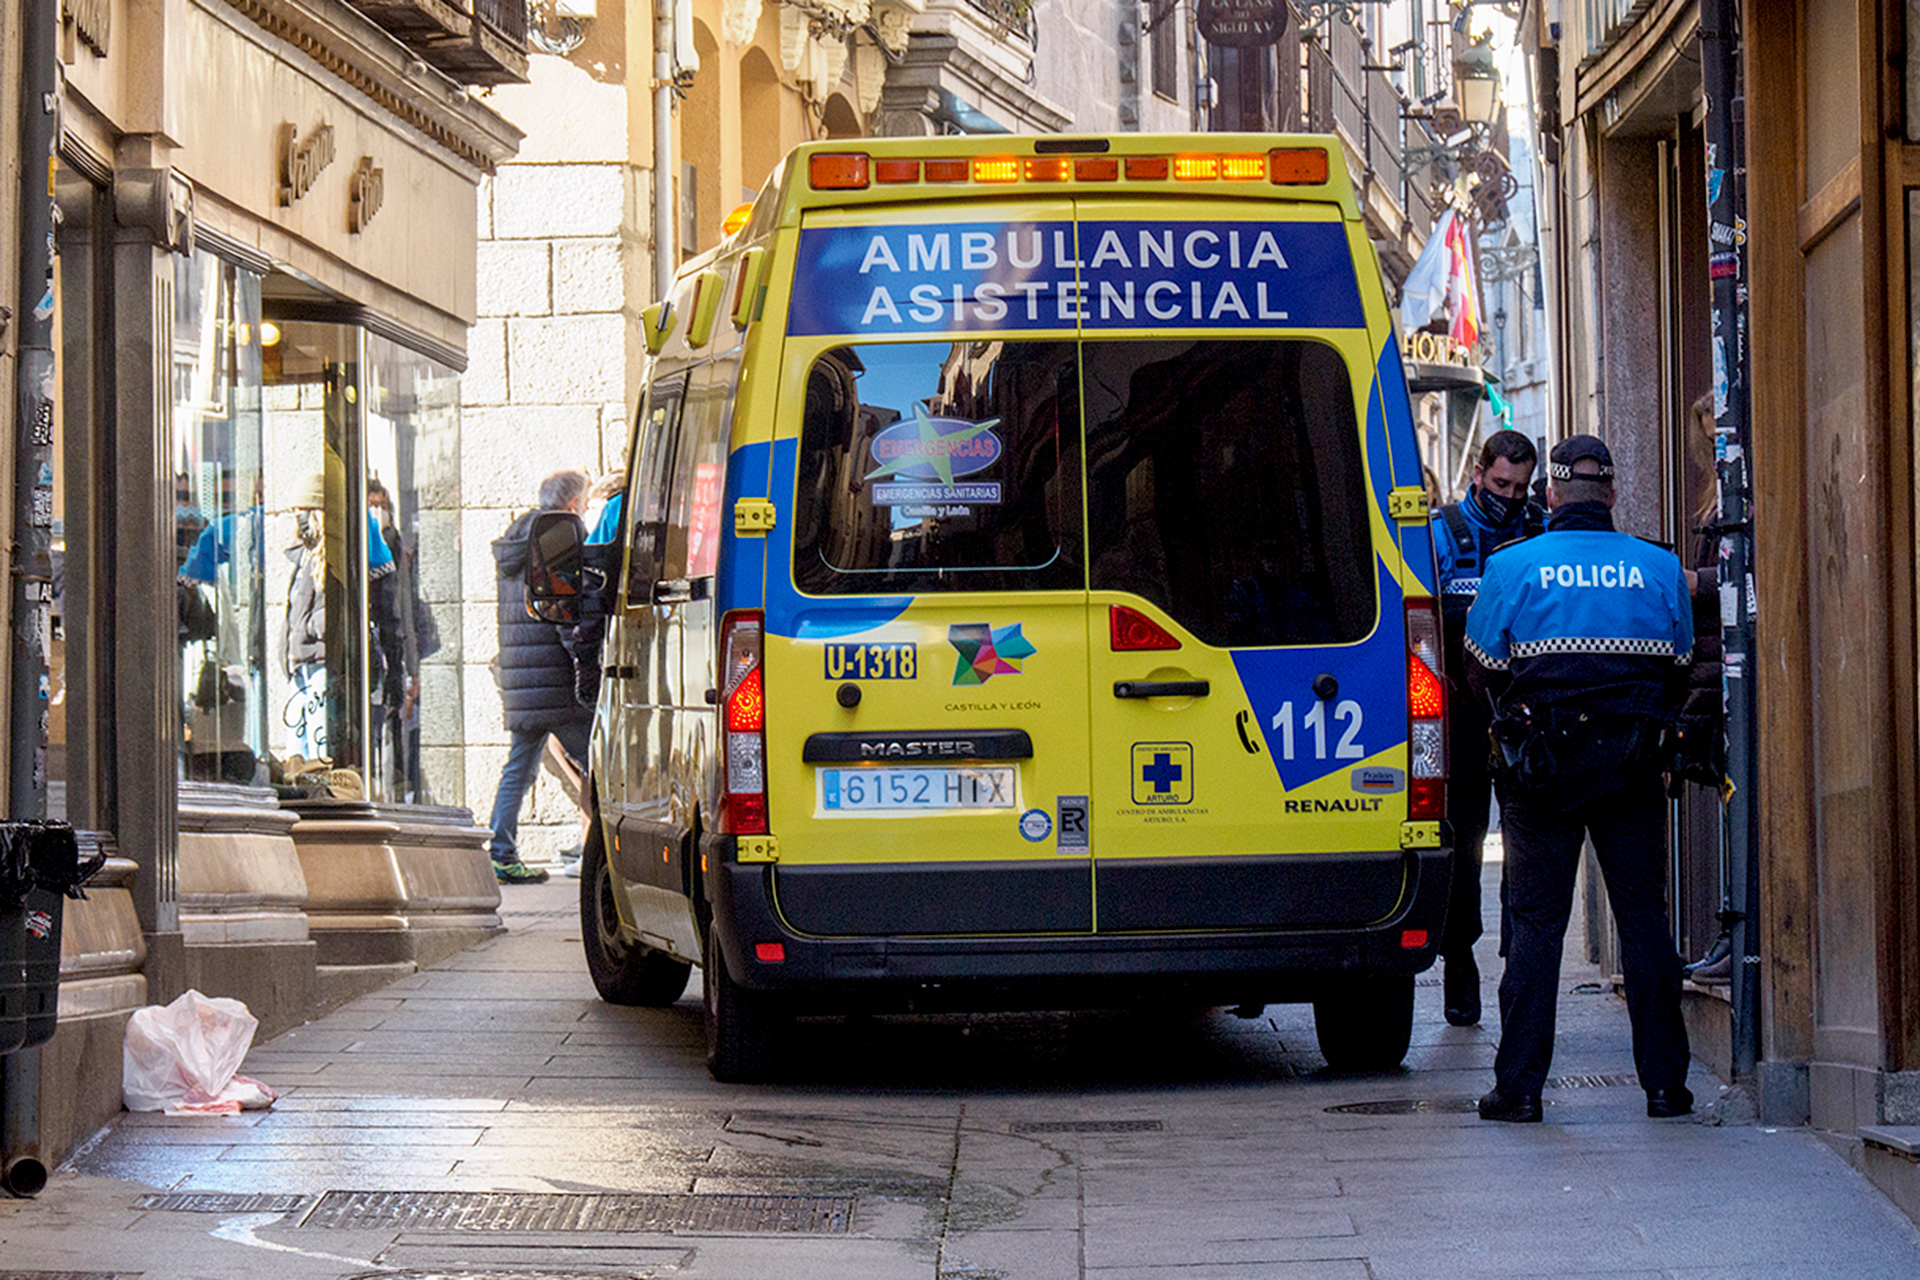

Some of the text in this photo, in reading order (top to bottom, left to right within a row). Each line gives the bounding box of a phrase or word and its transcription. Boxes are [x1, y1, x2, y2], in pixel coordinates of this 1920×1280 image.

[1212, 21, 1275, 33] SIGLO XV
[859, 229, 1288, 274] AMBULANCIA
[860, 280, 1288, 325] ASISTENCIAL
[880, 438, 994, 458] EMERGENCIAS
[876, 487, 998, 500] EMERGENCIAS SANITARIAS
[1540, 560, 1645, 588] POLICÍA
[827, 645, 915, 679] U-1318
[944, 699, 1042, 712] CASTILLA Y LEÓN
[1272, 699, 1365, 760] 112
[860, 741, 976, 757] MASTER
[847, 774, 931, 804] 6152
[944, 772, 1006, 803] HTX
[1284, 798, 1383, 813] RENAULT
[1061, 807, 1086, 832] ER
